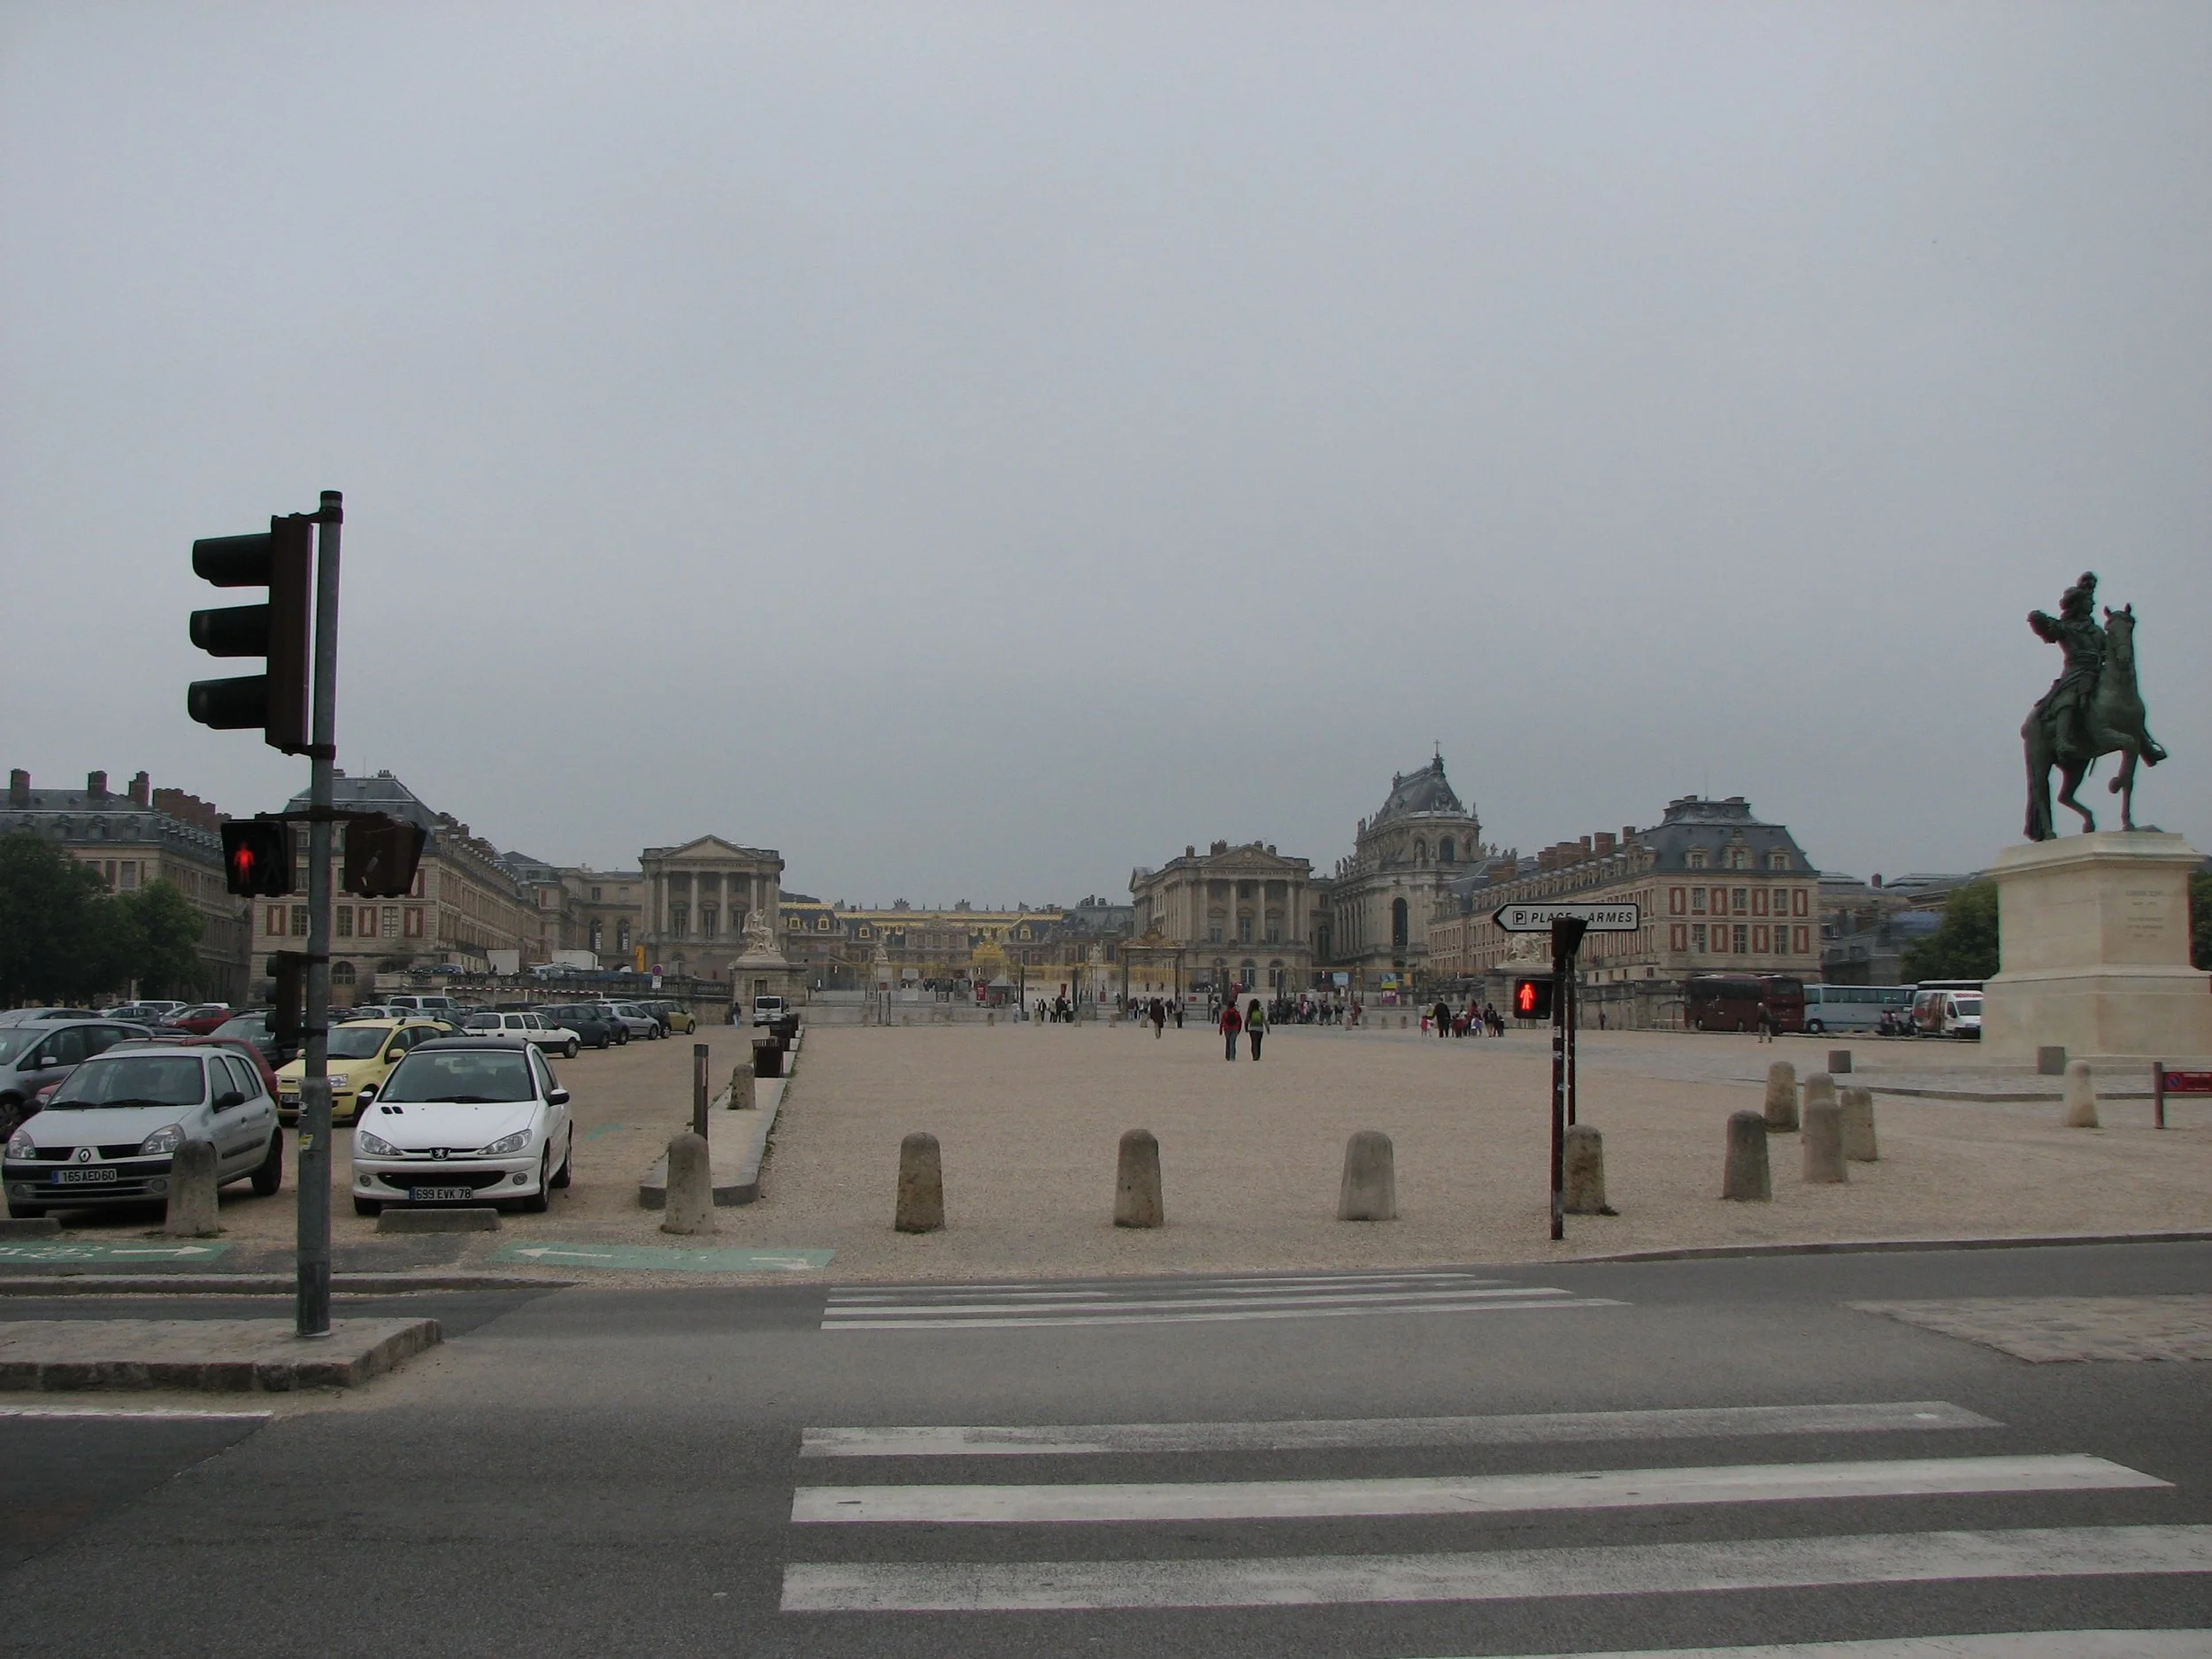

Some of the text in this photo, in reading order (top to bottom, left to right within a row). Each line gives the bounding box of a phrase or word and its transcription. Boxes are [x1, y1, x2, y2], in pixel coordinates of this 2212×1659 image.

[1515, 912, 1525, 923] P
[1588, 912, 1632, 923] ARMES
[416, 1188, 471, 1200] 699 EVK 78
